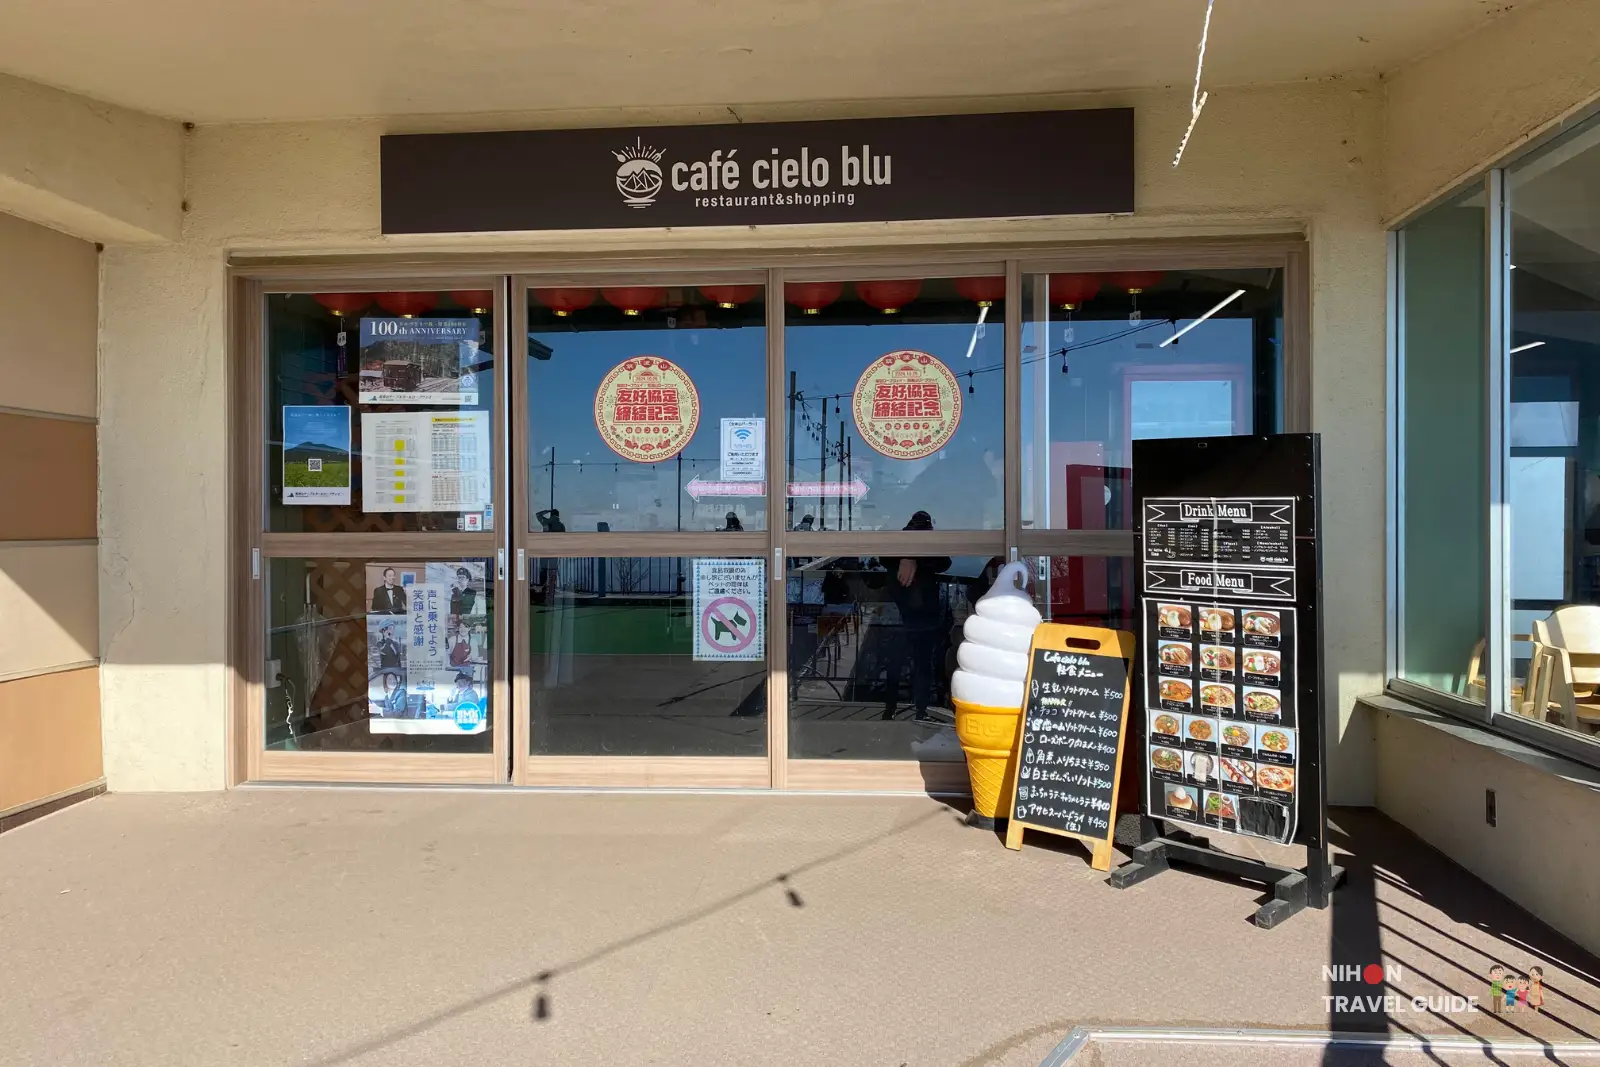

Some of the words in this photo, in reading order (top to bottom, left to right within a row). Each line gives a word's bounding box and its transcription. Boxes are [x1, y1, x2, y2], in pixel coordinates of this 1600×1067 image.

[671, 149, 740, 191] café
[752, 147, 829, 188] cielo
[841, 145, 892, 186] blu
[695, 192, 855, 207] restaurant&shopping
[409, 327, 467, 335] ANNIVERSARY
[617, 389, 677, 403] 友好協定
[876, 384, 938, 399] 友好協定
[615, 405, 679, 421] 締結記念
[874, 401, 940, 417] 締結記念
[1184, 505, 1214, 517] Drink
[1218, 505, 1248, 518] Menu
[1187, 573, 1212, 586] Food
[1215, 574, 1245, 588] Menu
[413, 589, 424, 647] 笑顔と感謝
[427, 589, 438, 657] 声に乗せよう
[1056, 664, 1104, 678] 軽食メニュー
[1104, 687, 1123, 699] ¥500
[1098, 710, 1118, 721] ¥500
[1098, 726, 1118, 738] ¥600
[1088, 759, 1110, 771] ¥350
[1088, 816, 1108, 830] ¥450
